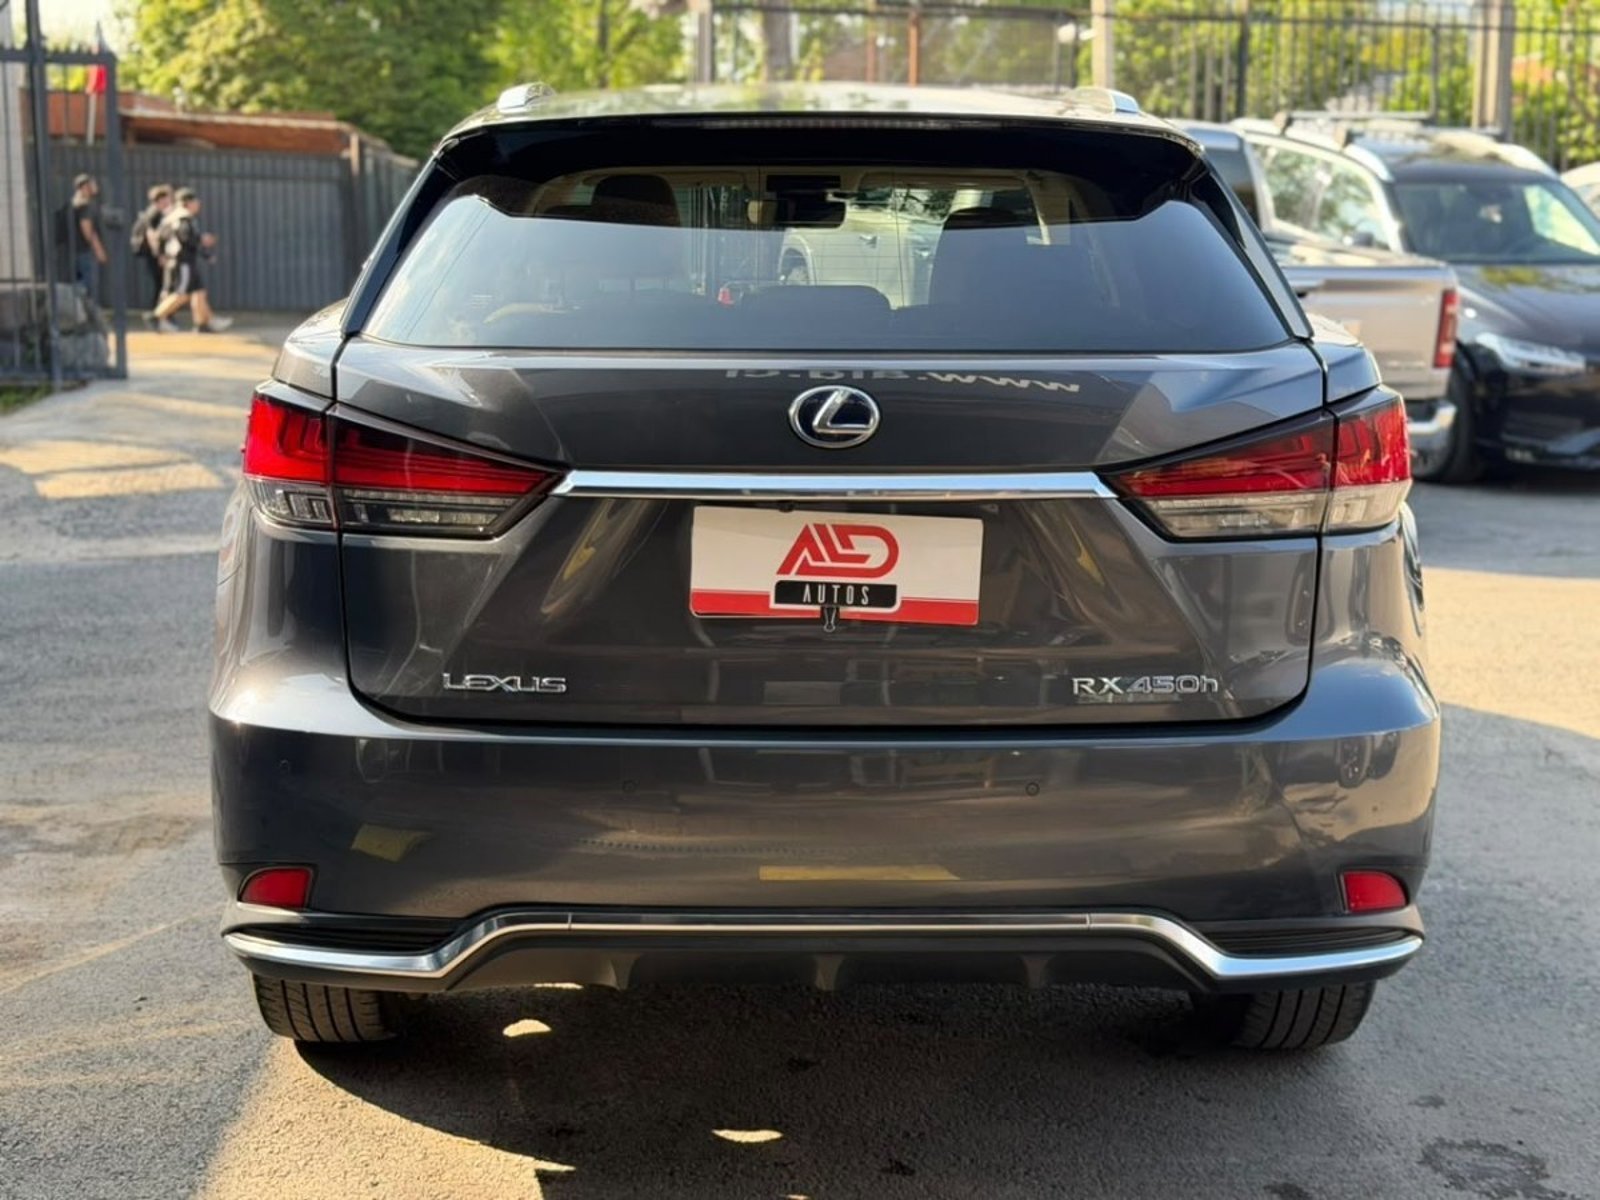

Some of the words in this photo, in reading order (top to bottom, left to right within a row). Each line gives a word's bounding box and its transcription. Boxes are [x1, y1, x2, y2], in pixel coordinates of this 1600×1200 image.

[803, 583, 870, 606] AUTOS
[442, 673, 568, 693] LEXUS
[1072, 676, 1123, 695] RX
[1126, 674, 1219, 694] 450h
